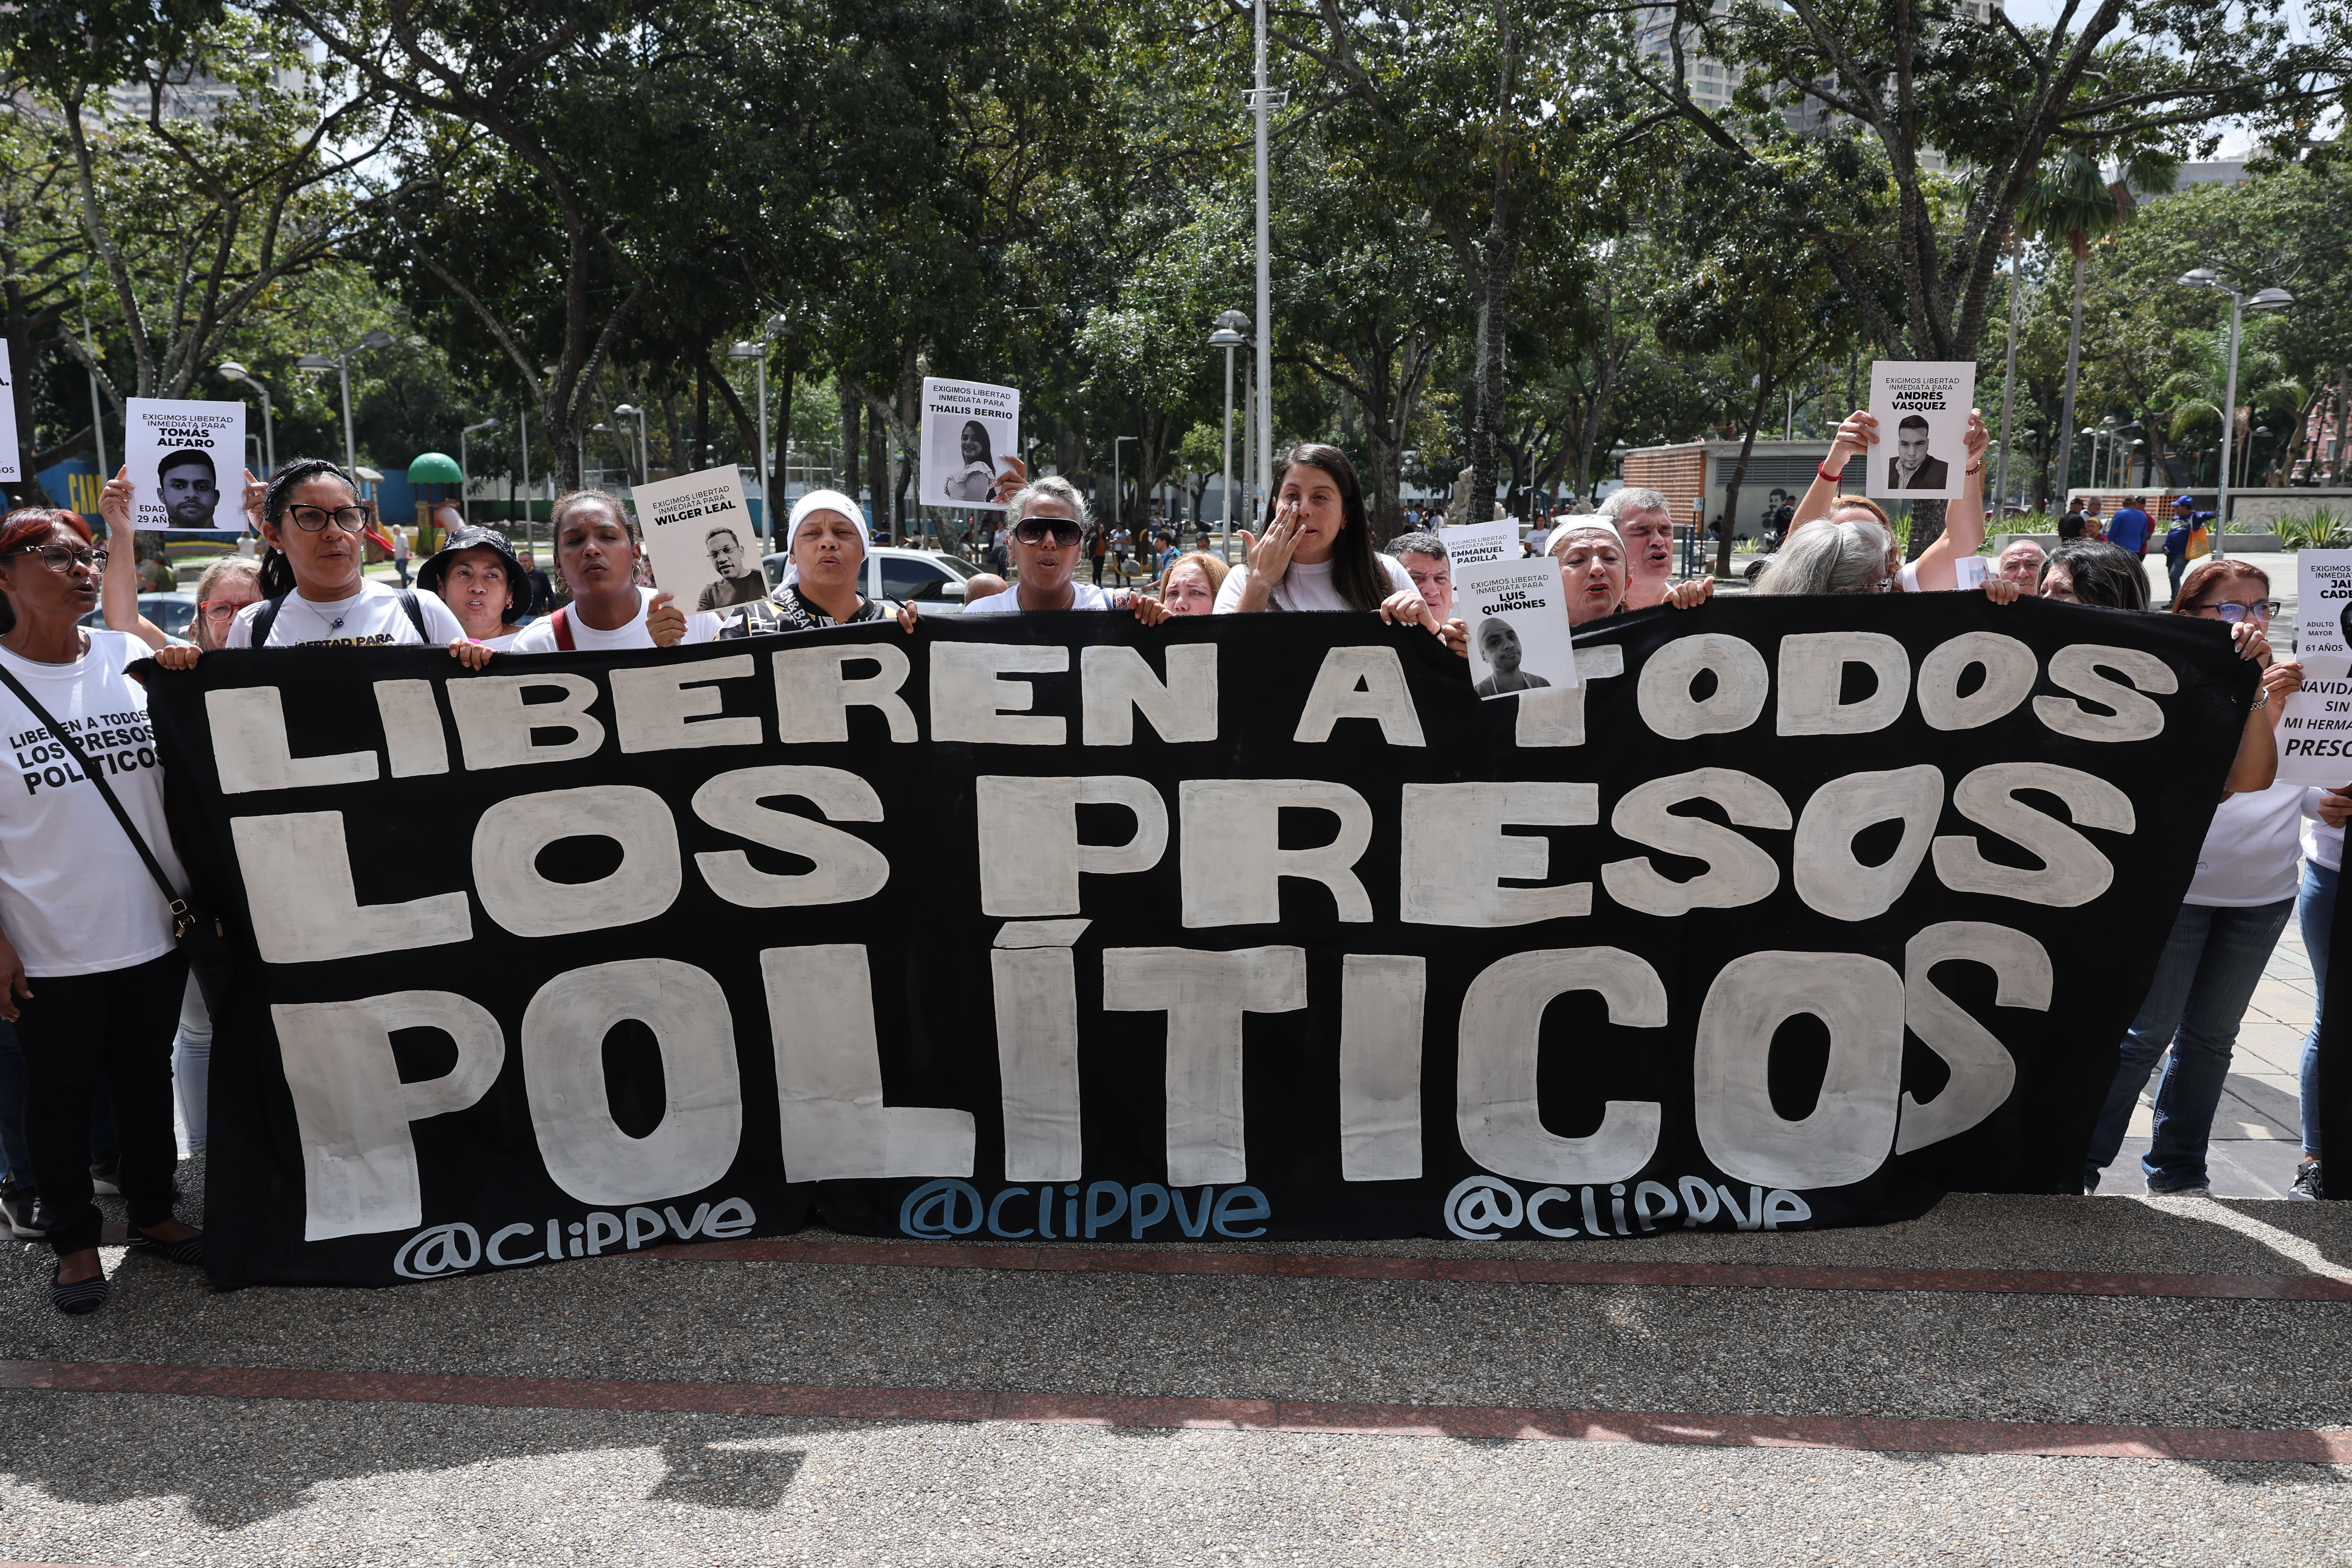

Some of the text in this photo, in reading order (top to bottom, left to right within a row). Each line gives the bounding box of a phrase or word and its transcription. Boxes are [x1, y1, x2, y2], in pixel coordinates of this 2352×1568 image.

[933, 385, 1011, 399] EXIGIMOS LIBERTAD
[1896, 389, 1943, 400] ANDRÉS
[939, 394, 1005, 407] INMEDIATA PARA
[1892, 401, 1946, 412] VASQUEZ
[929, 404, 1013, 419] THAILIS BERRIO
[159, 426, 209, 437] TOMÁS
[157, 438, 215, 448] ALFARO
[653, 486, 730, 509] EXIGIMOS LIBERTAD
[659, 494, 725, 515] INMEDIATA PARA
[654, 500, 736, 526] WILGER LEAL
[1448, 538, 1476, 546] EXIGIMOS
[1451, 543, 1484, 551] INMEDIATA
[1451, 546, 1504, 557] EMMANUEL
[1457, 554, 1498, 564] PADILLA
[1471, 575, 1548, 589] EXIGIMOS LIBERTAD
[2331, 580, 2352, 588] JAI
[1476, 584, 1520, 595] INMEDIATA
[1499, 591, 1526, 602] LUIS
[1482, 599, 1546, 615] QUIÑONES
[356, 633, 396, 646] PARA
[2318, 643, 2343, 652] AÑOS
[205, 632, 2178, 794] LIBEREN A TODOS
[2325, 701, 2350, 712] SIN
[87, 717, 99, 730] A
[99, 710, 150, 726] TODOS
[2284, 717, 2303, 728] MI
[2285, 739, 2352, 757] PRESO
[16, 742, 65, 769] LOS
[23, 745, 164, 795] POLTICO
[230, 762, 2136, 964] LOS PRESOS
[270, 919, 2053, 1241] POLÍTICOS
